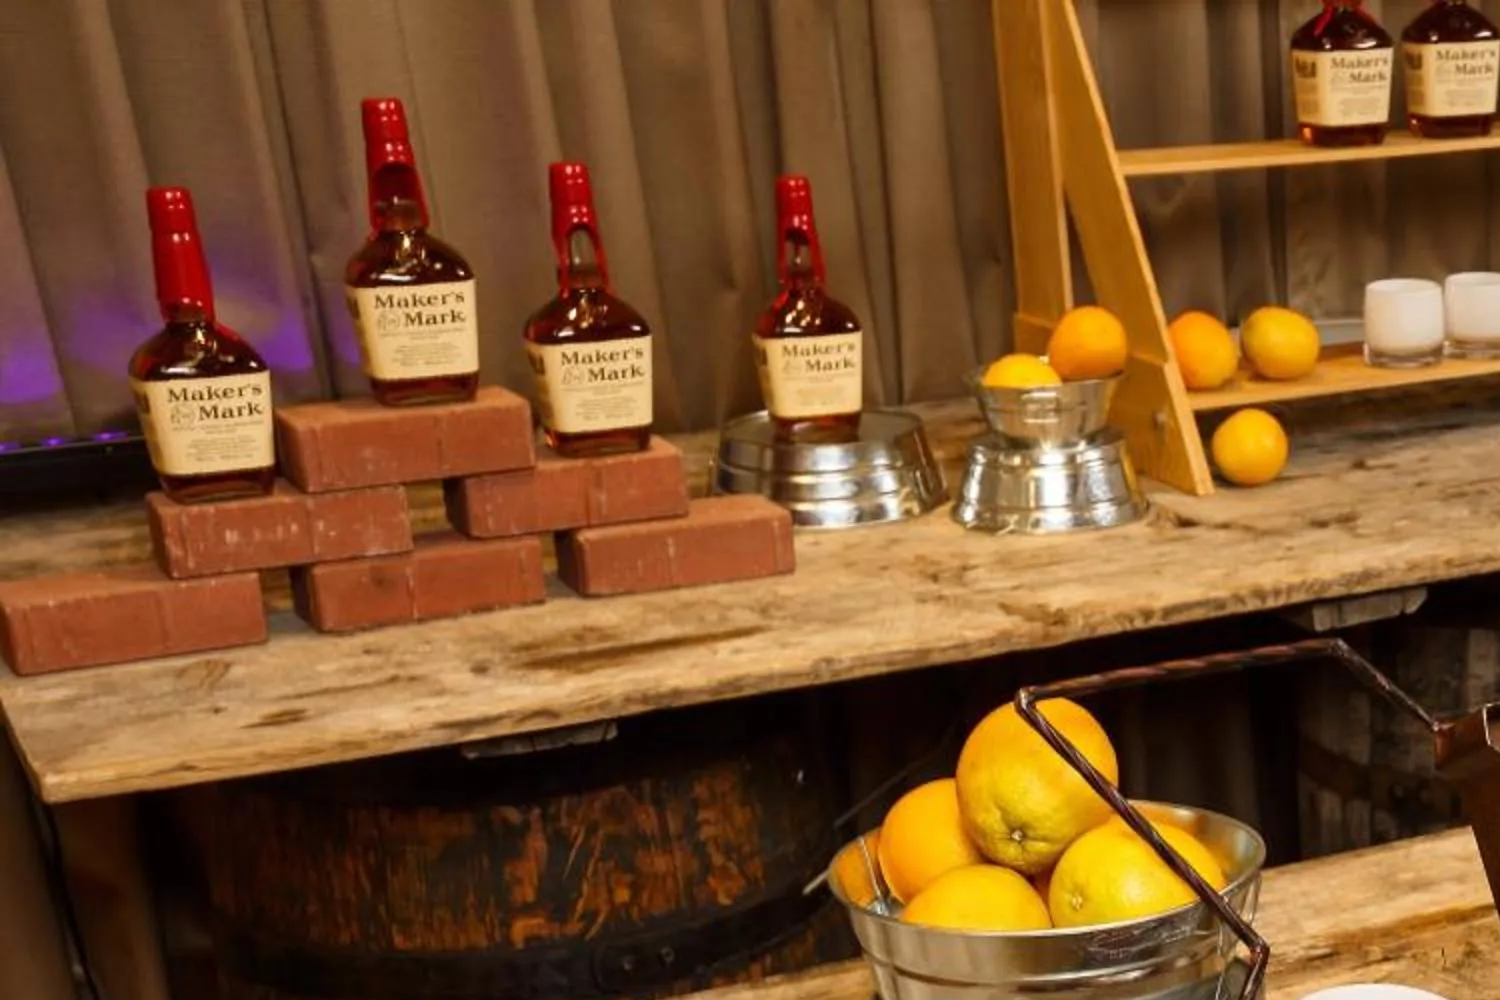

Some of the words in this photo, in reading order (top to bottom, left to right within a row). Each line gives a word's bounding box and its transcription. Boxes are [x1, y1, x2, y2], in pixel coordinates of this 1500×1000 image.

[1348, 70, 1388, 84] Mark
[1454, 62, 1494, 75] Mark
[373, 290, 466, 309] Maker's
[404, 308, 467, 328] Mark
[560, 346, 645, 366] Maker's
[781, 341, 857, 358] Maker's
[587, 364, 646, 383] Mark
[804, 356, 857, 373] Mark
[167, 383, 264, 403] Maker's
[198, 402, 264, 421] Mark
